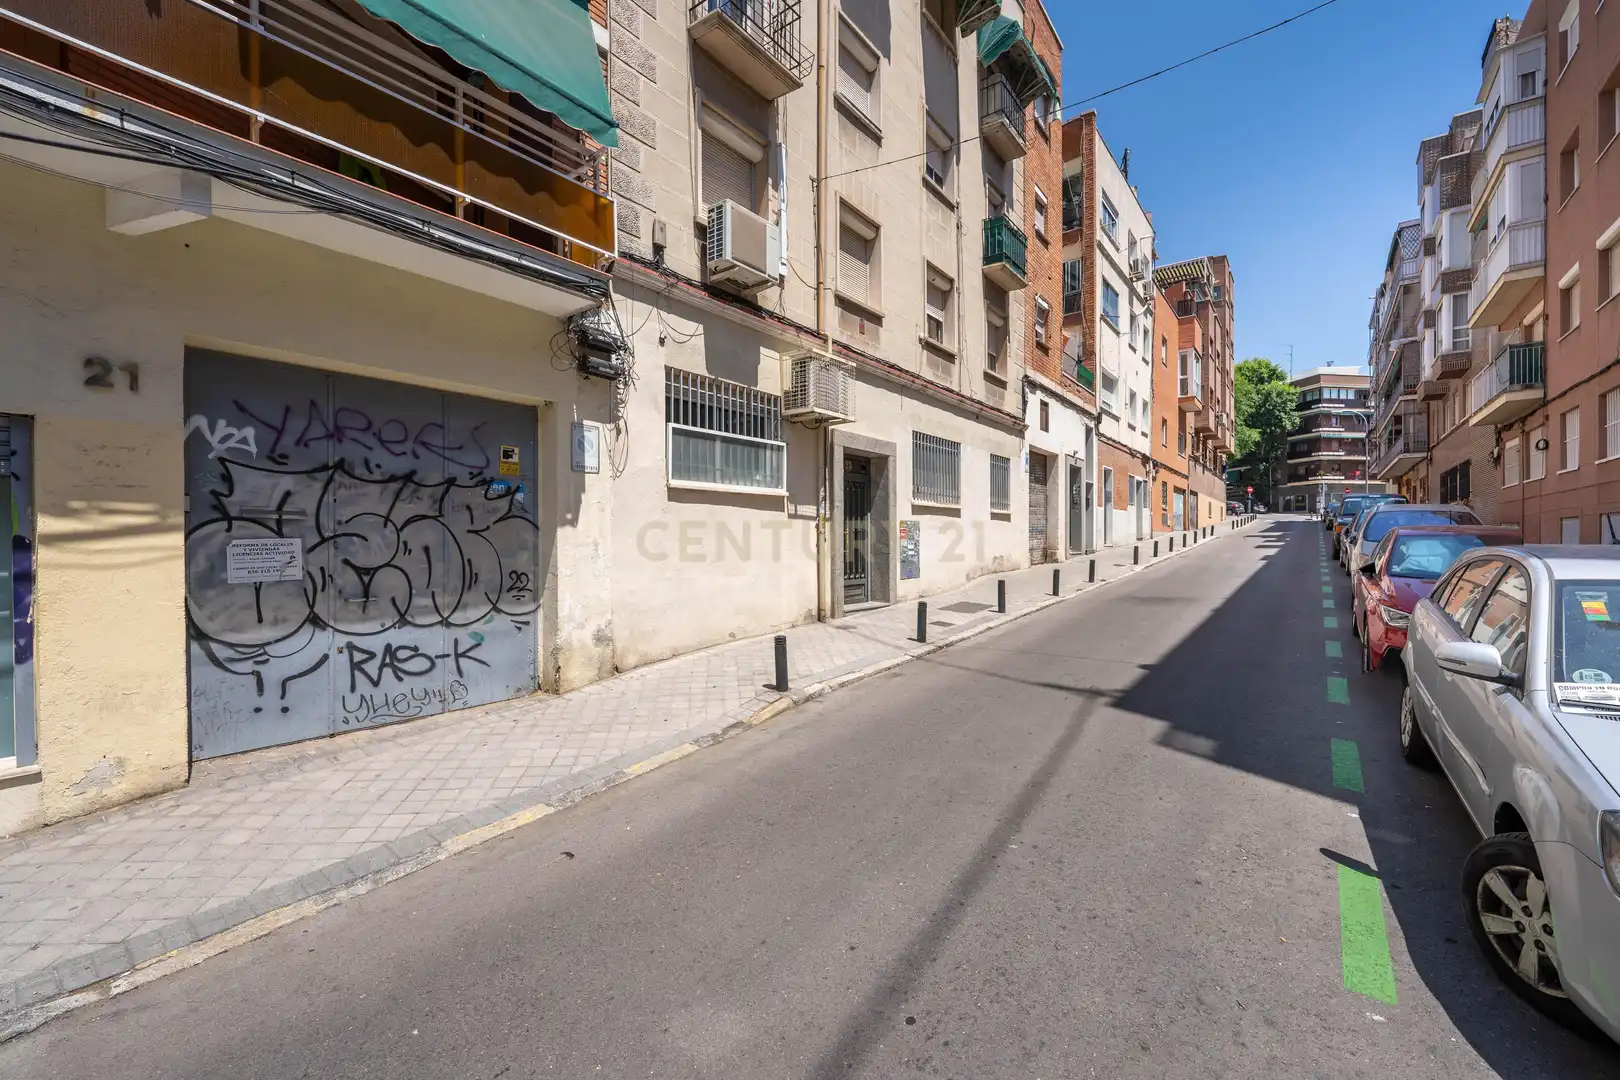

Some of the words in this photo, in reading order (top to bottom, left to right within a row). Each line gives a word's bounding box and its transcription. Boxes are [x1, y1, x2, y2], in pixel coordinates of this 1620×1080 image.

[83, 356, 139, 392] 21
[506, 570, 533, 593] 22
[346, 636, 491, 693] RAS-K
